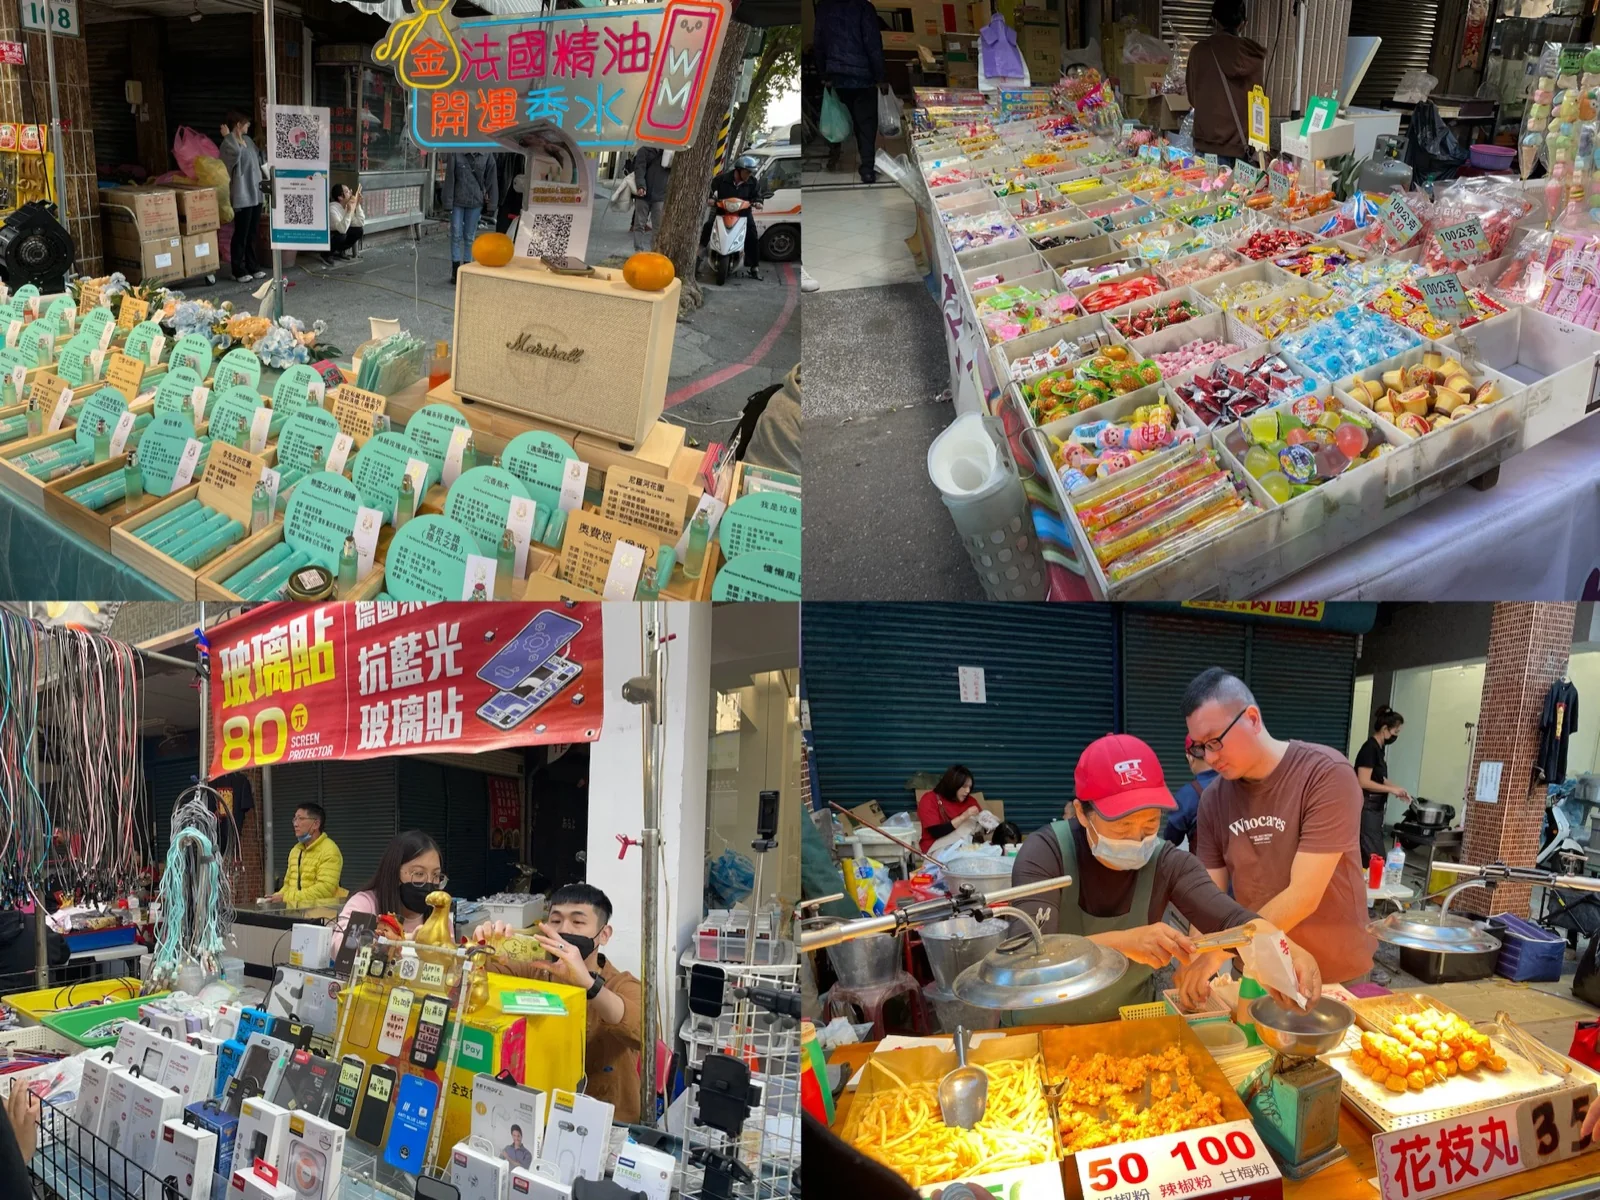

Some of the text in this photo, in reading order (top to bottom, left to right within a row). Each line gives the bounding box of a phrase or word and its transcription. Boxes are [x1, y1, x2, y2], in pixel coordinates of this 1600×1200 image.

[460, 20, 651, 83] 法國精油
[431, 82, 626, 139] 開運香水
[1389, 197, 1418, 231] 100公克
[1440, 223, 1479, 242] 100公克
[1422, 278, 1459, 296] 100公克
[505, 331, 585, 364] Marshall
[760, 500, 798, 516] 我是垃圾
[429, 523, 461, 544] 冥府之路
[355, 601, 445, 631] 德國
[218, 607, 336, 710] 玻璃貼
[358, 621, 463, 697] 抗藍光
[357, 686, 463, 752] 玻璃貼
[221, 706, 288, 771] 80
[288, 744, 334, 761] PROTECTOR
[291, 732, 320, 748] SCREEN
[421, 973, 440, 983] Watch
[423, 963, 440, 973] Apple
[464, 1042, 481, 1056] Pay
[1088, 1131, 1256, 1192] 50 100
[1390, 1116, 1519, 1198] 花枝丸
[616, 1166, 642, 1180] STEREO
[1158, 1175, 1212, 1198] 辣椒粉
[1219, 1163, 1270, 1184] 甘梅粉
